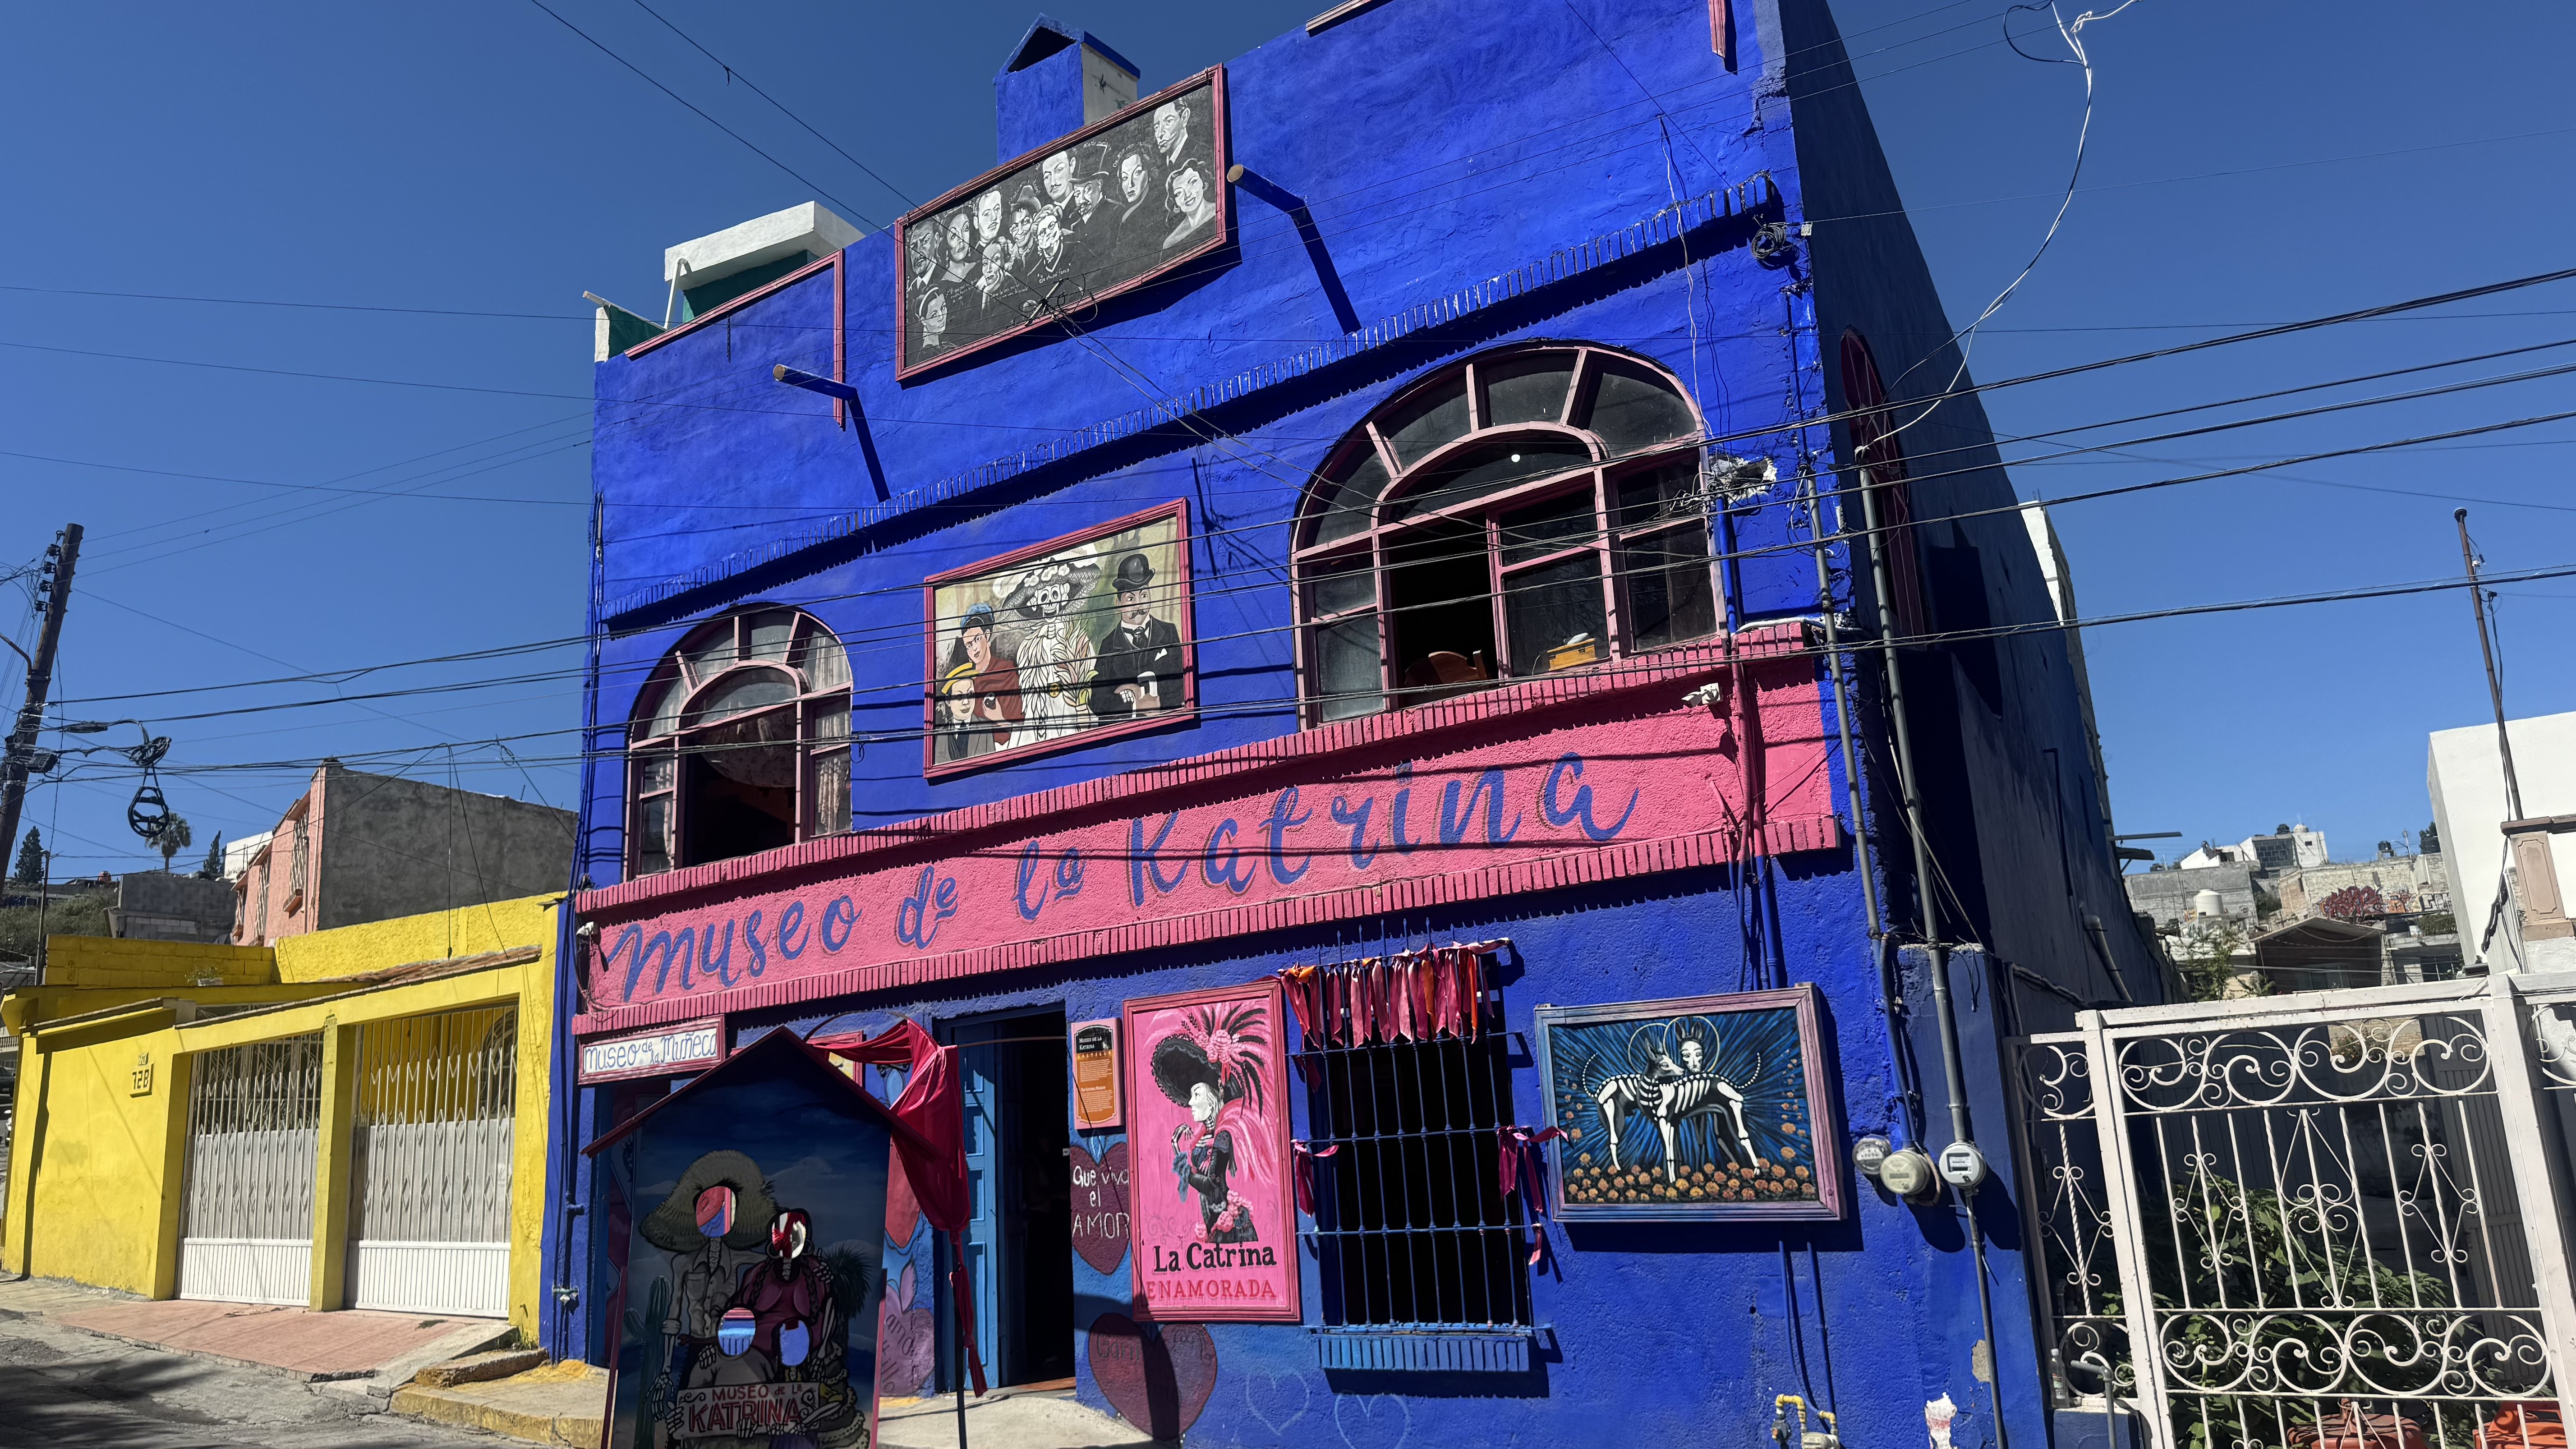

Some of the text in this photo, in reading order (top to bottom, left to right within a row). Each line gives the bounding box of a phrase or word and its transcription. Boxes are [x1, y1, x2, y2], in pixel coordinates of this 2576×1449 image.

[898, 865, 959, 950] de
[1012, 840, 1085, 920] la
[1129, 751, 1639, 907] Katrina
[642, 1038, 653, 1052] de
[649, 1049, 660, 1064] la
[1089, 1184, 1101, 1208] el
[1072, 1211, 1130, 1239] AMOR
[1153, 1241, 1277, 1273] La Catrina
[1145, 1279, 1277, 1300] ENAMORADA
[712, 1384, 769, 1402] MUSEO
[774, 1385, 786, 1395] de
[689, 1397, 802, 1433] KATRINA
